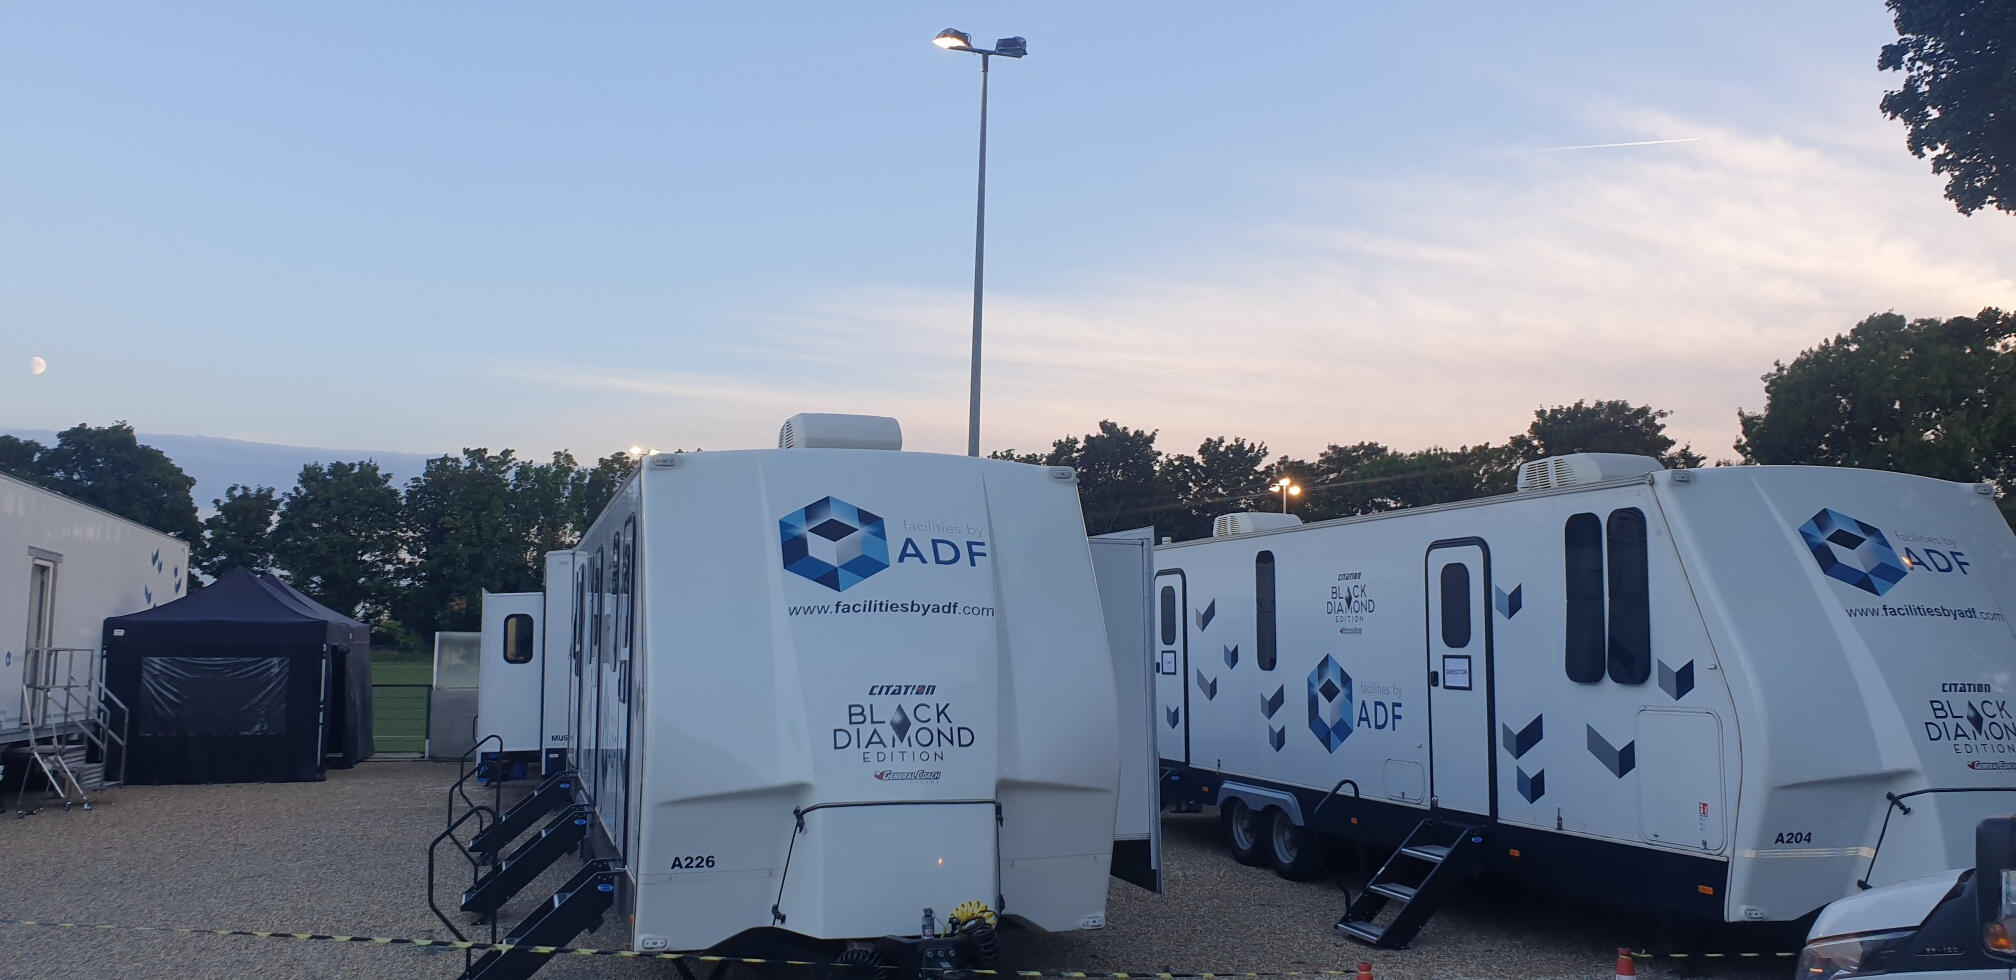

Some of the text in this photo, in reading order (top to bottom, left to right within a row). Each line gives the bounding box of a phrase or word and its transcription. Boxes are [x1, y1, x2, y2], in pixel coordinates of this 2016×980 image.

[903, 520, 984, 537] facilities by
[897, 537, 987, 567] ADF
[1902, 546, 1971, 575] ADF
[1331, 584, 1367, 599] BLACK
[788, 600, 995, 617] www.facilitiesbyadf.com
[1326, 599, 1375, 615] DIAMOND
[1845, 604, 2003, 621] www.facilitiesbyadf.com
[1335, 615, 1364, 623] EDITION
[869, 684, 937, 696] CITATION
[1360, 680, 1403, 699] facilities by
[848, 702, 953, 725] BLACK
[1357, 700, 1403, 731] ADF
[1930, 700, 2013, 719] BLACK
[833, 727, 975, 750] DIAMOND
[1924, 721, 2016, 741] DIAMON
[863, 751, 944, 763] EDITION
[1953, 743, 2016, 754] EDITION
[1774, 832, 1812, 844] A204
[671, 855, 716, 870] A226
